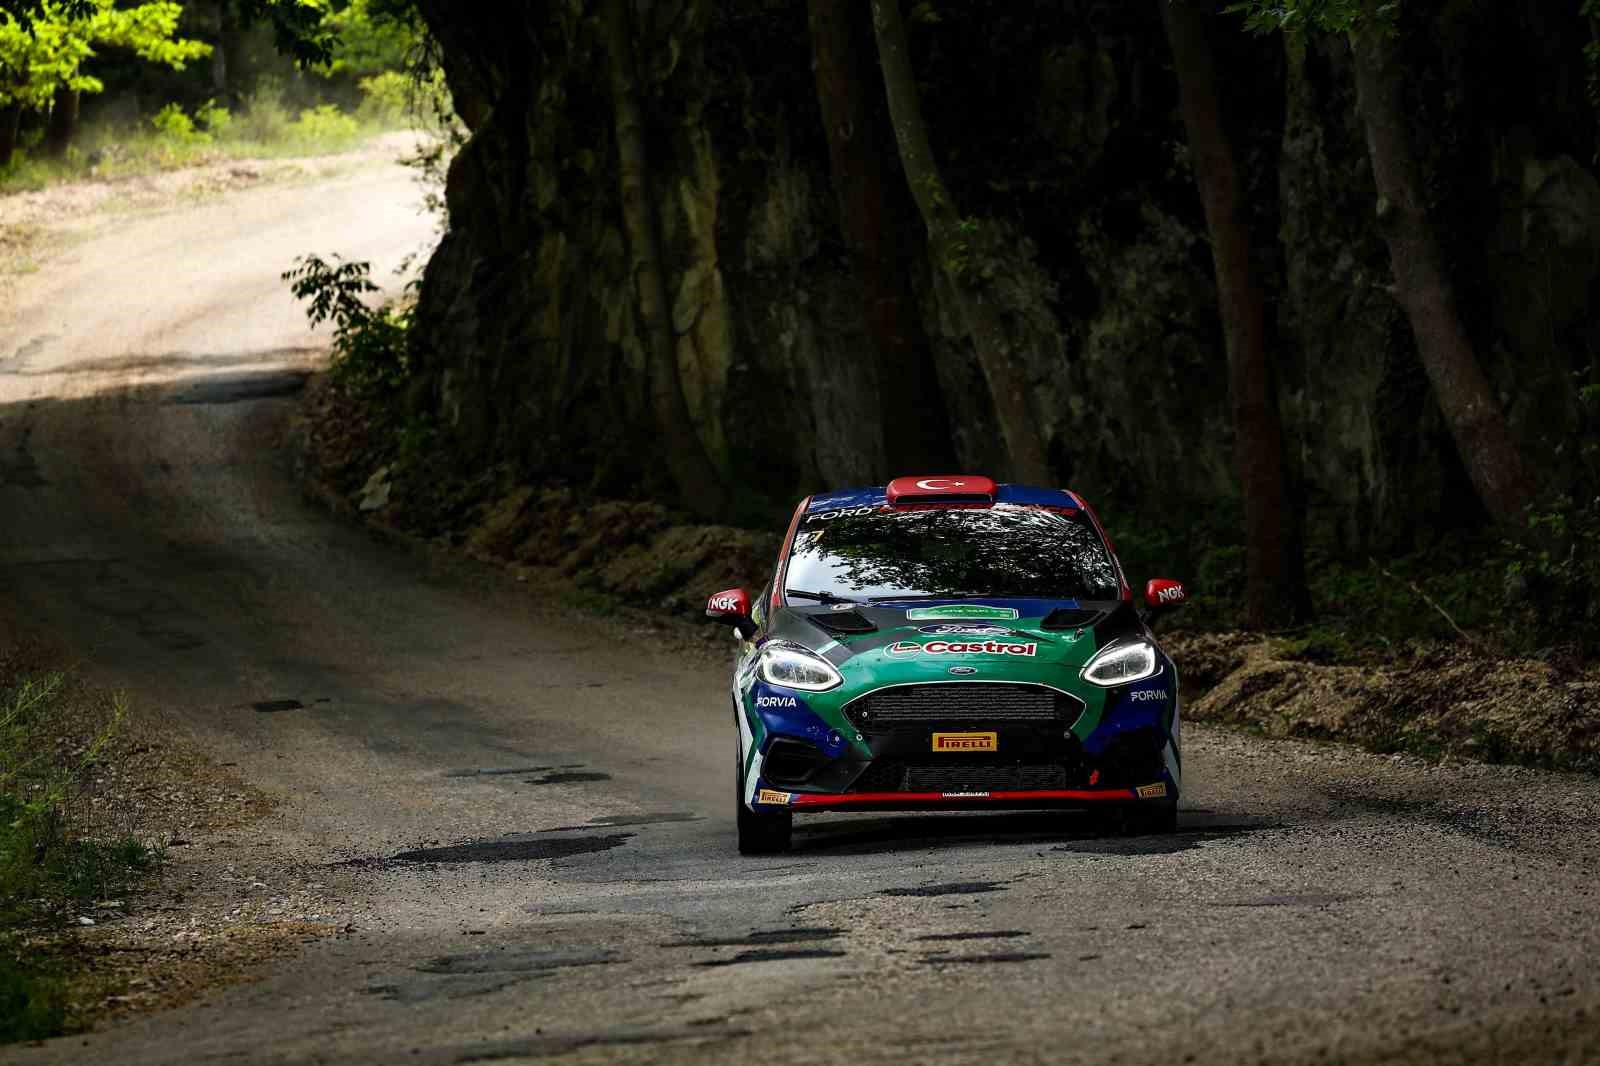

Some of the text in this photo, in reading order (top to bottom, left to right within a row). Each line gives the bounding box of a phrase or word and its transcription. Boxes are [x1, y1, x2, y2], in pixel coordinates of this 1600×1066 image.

[806, 507, 874, 524] FORD
[1158, 585, 1184, 603] NGK
[711, 597, 738, 610] NGK
[924, 641, 1037, 656] Castrol
[757, 696, 797, 708] FORVIA
[1130, 690, 1168, 702] FORVIA
[938, 736, 992, 748] PIRELLI
